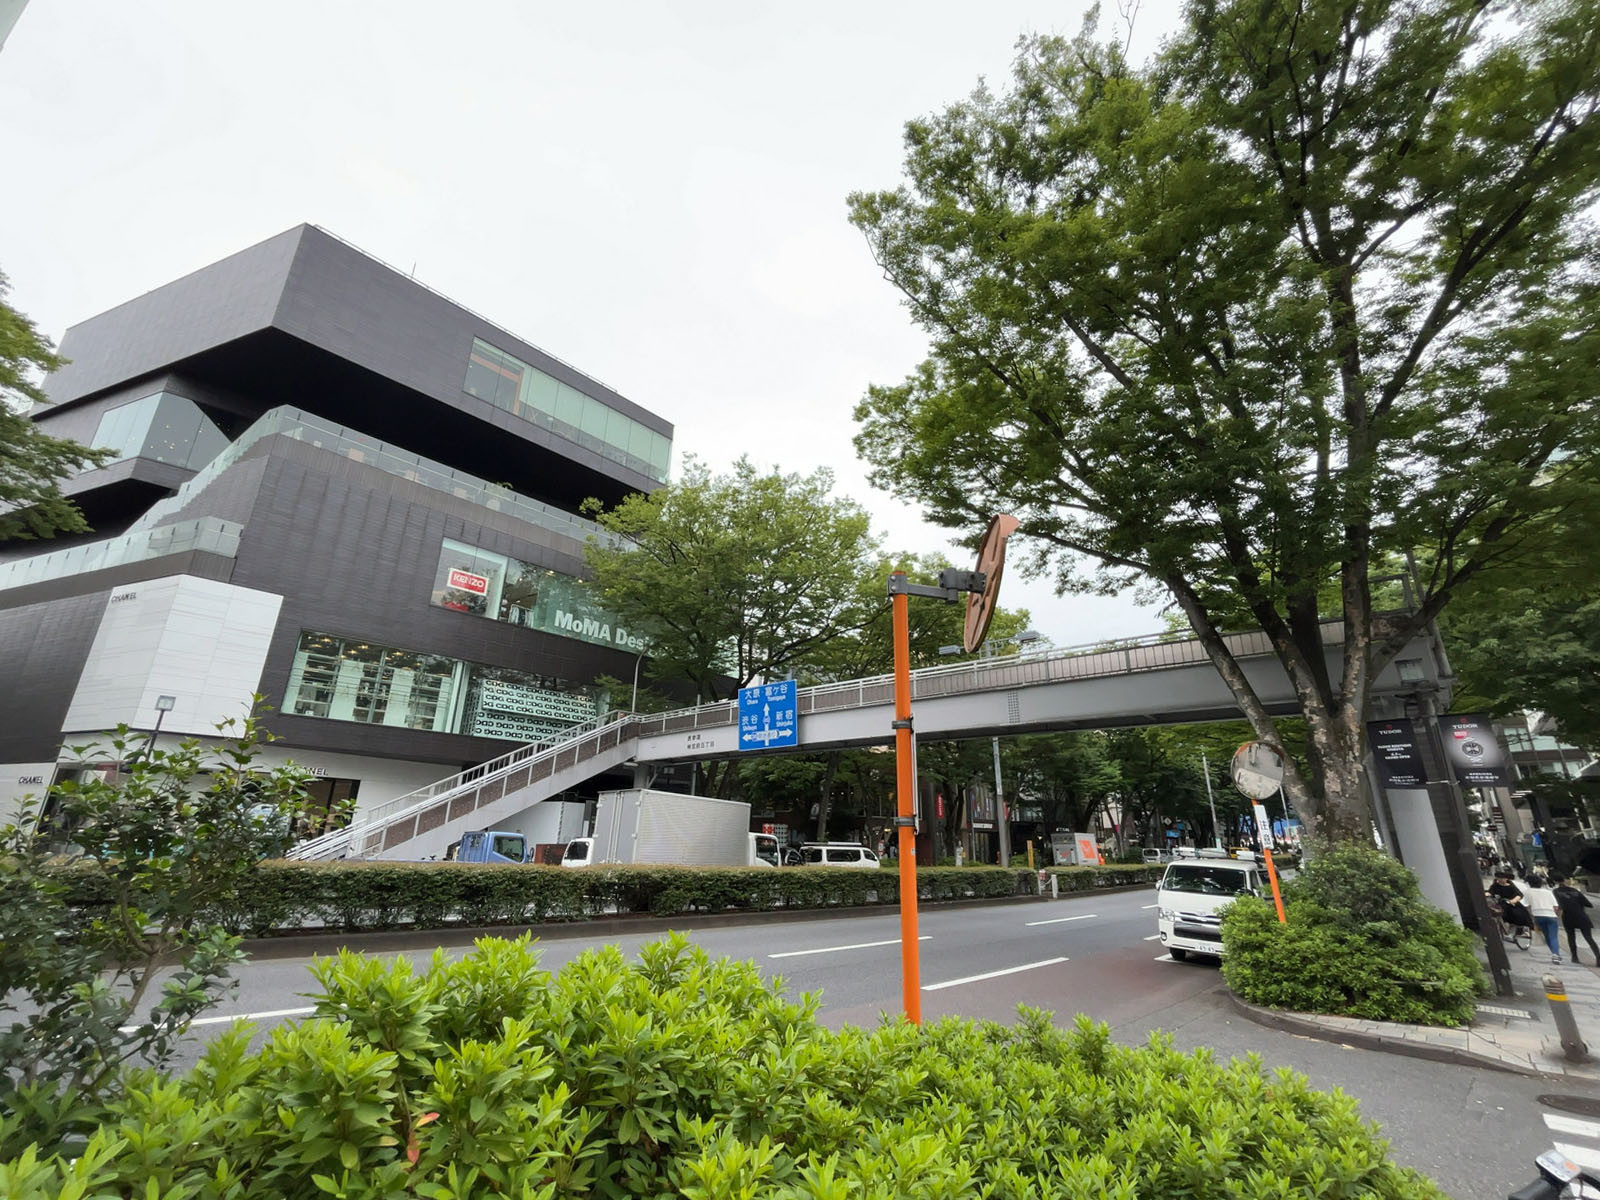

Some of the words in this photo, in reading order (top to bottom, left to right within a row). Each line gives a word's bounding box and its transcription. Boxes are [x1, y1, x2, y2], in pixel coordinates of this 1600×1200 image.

[453, 573, 484, 588] KENZO
[111, 592, 137, 603] CHANEL
[554, 609, 611, 642] MoMA
[18, 776, 43, 784] CHANEL
